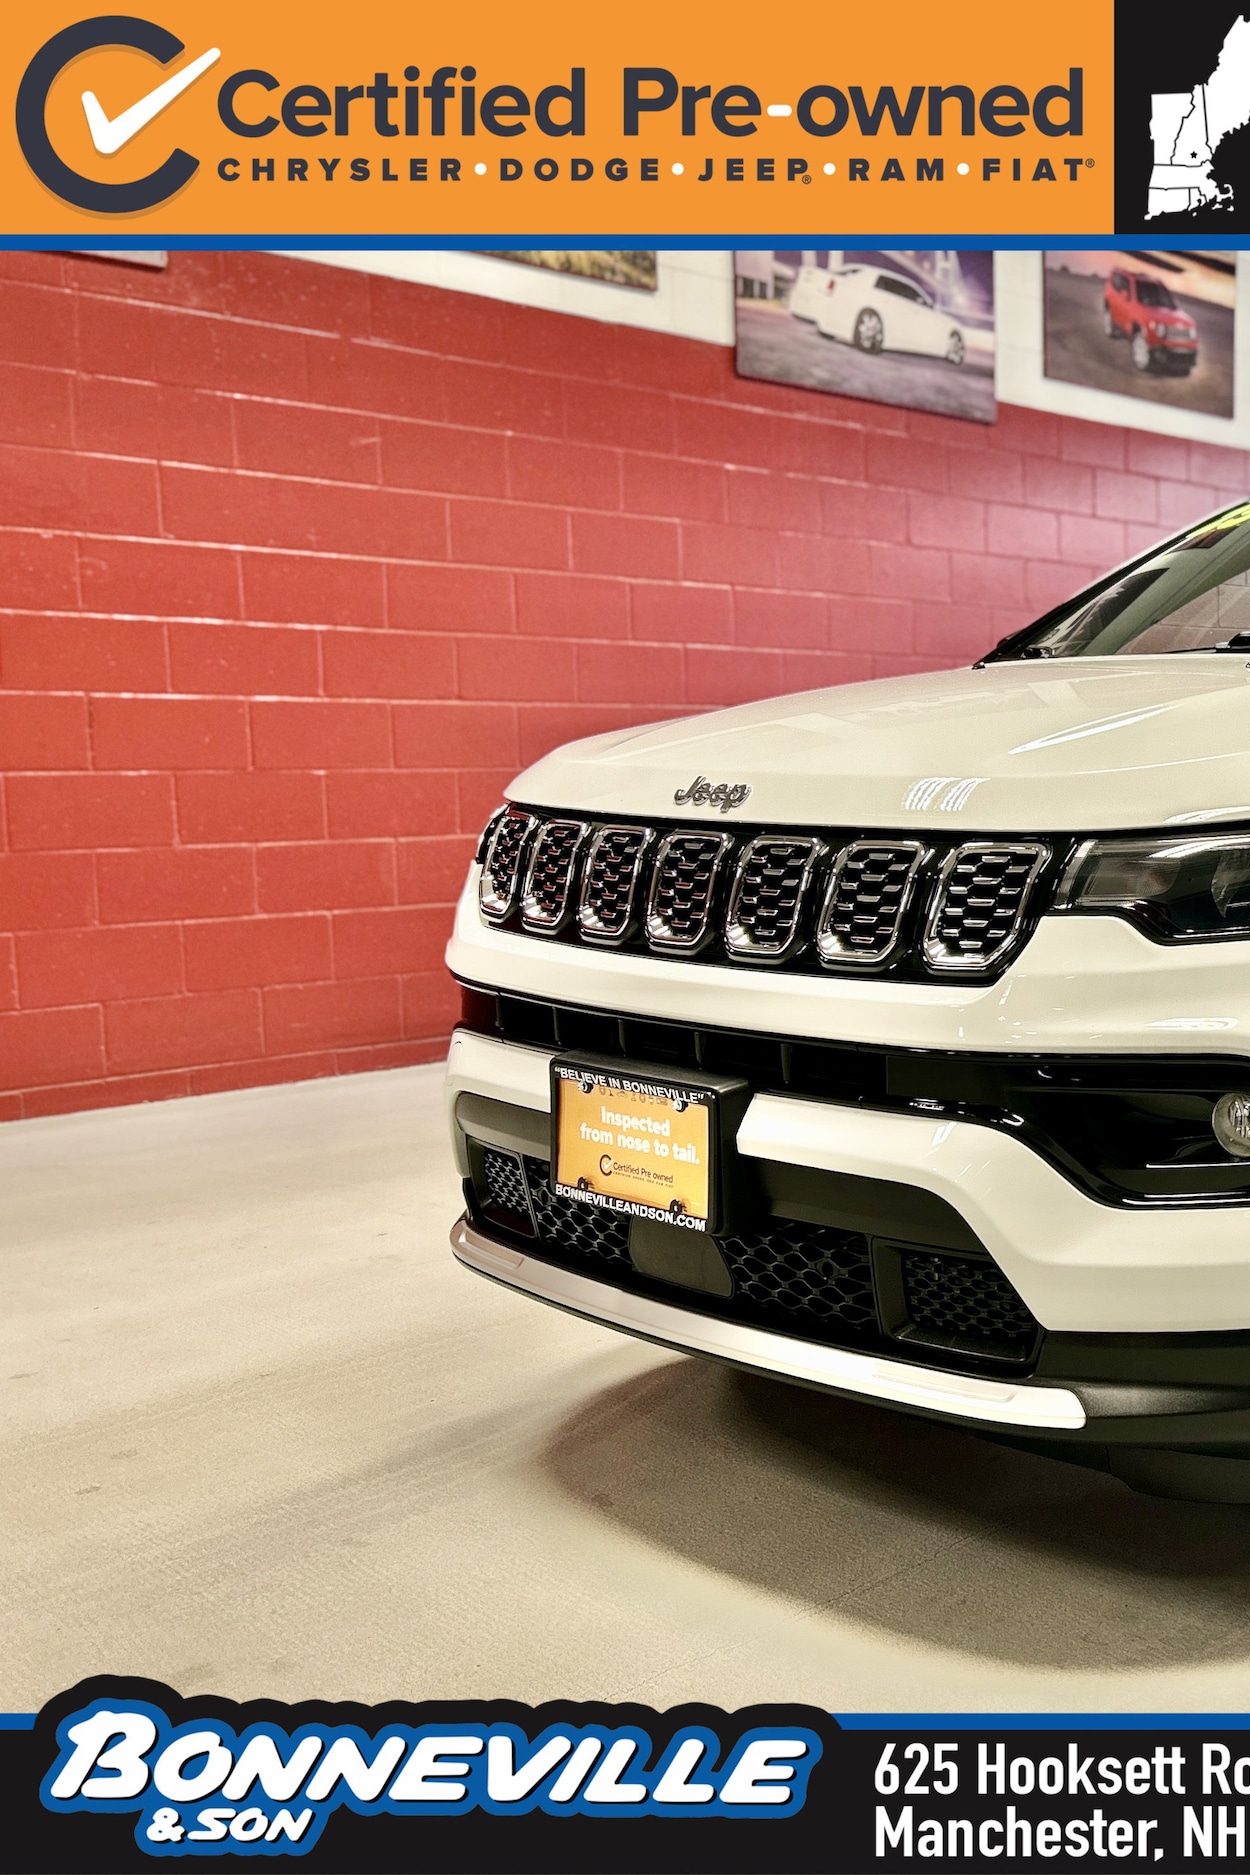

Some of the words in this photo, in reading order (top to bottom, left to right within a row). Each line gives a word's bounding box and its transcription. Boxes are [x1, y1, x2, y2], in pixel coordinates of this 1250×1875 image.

[674, 775, 752, 813] Jeep
[608, 1077, 621, 1090] IN
[600, 1105, 671, 1137] Inspected
[580, 1122, 613, 1145] from
[617, 1134, 651, 1153] nose
[653, 1139, 670, 1156] to
[672, 1141, 701, 1165] tail.
[612, 1161, 640, 1176] Certified
[640, 1167, 651, 1179] Pre
[652, 1172, 674, 1184] owned
[555, 1183, 706, 1232] BONNEVILLEANDSON.COM
